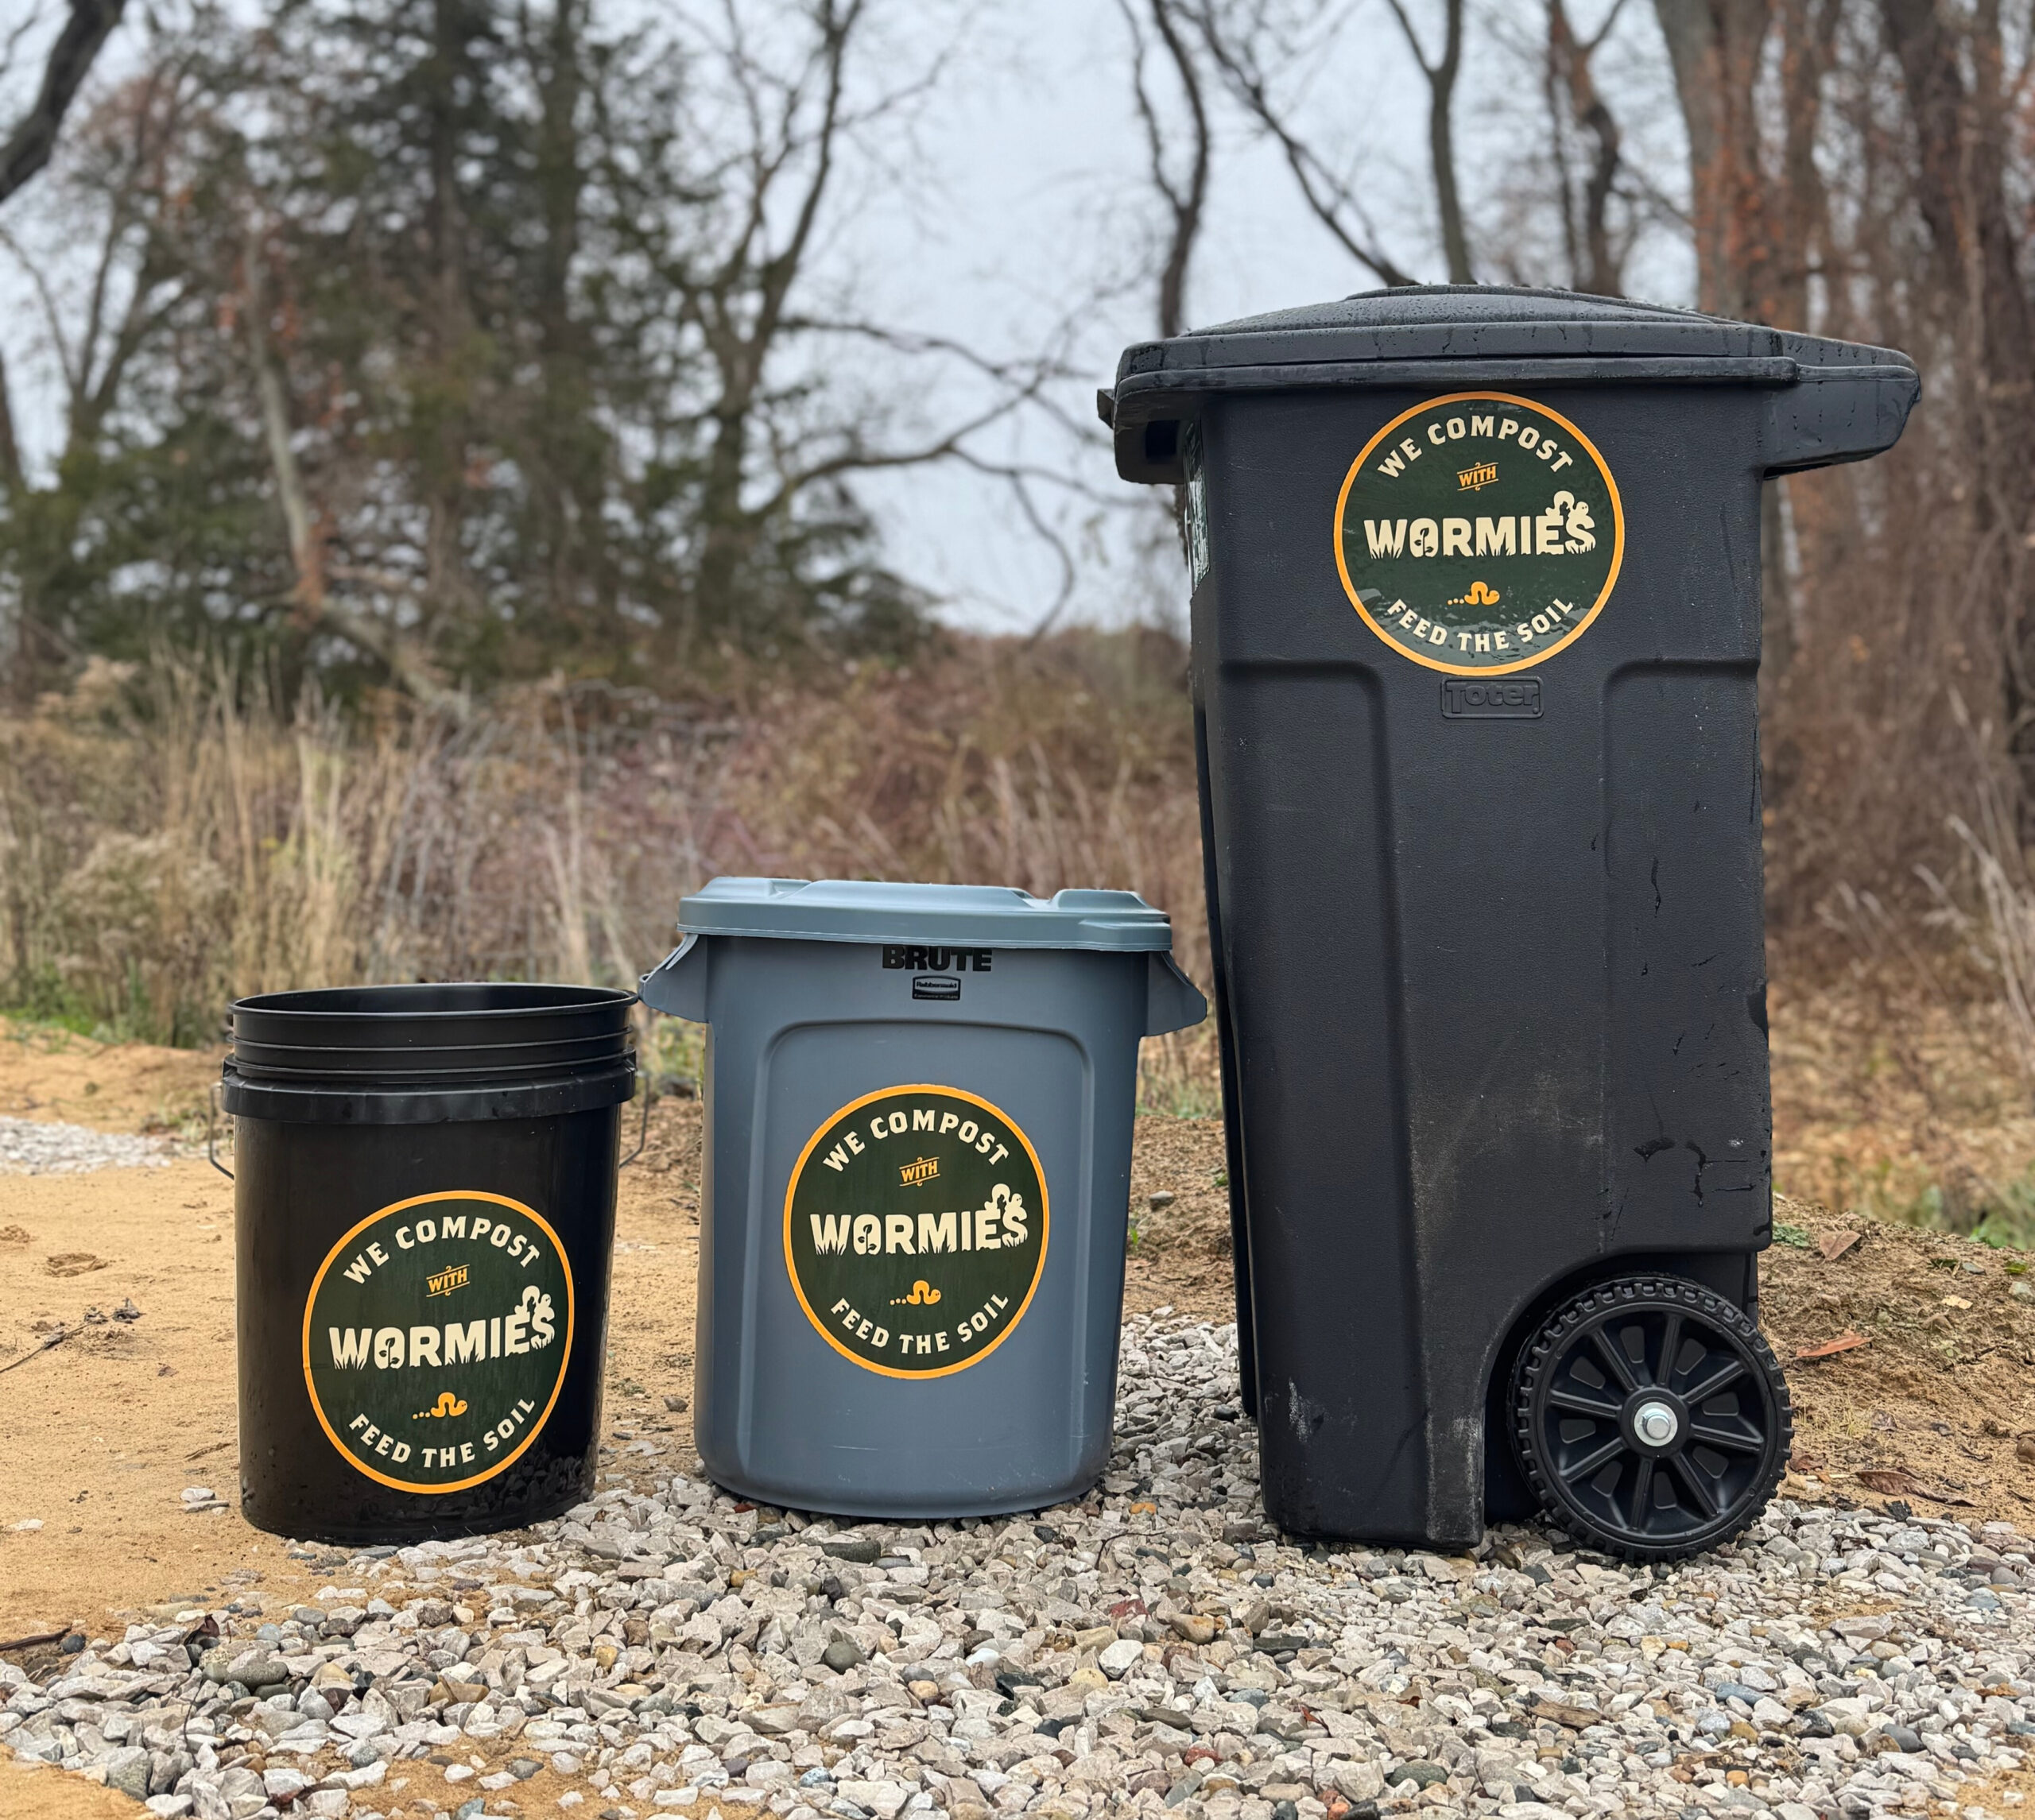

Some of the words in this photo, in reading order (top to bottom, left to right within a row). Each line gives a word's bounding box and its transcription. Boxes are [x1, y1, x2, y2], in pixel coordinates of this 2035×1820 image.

[1378, 437, 1422, 477] WE
[1427, 415, 1573, 473] COMPOST
[1459, 467, 1496, 487] WITH
[1363, 514, 1596, 559] WORMIES
[1387, 598, 1447, 645] FEED
[1458, 630, 1510, 652] THE
[1520, 598, 1573, 642] SOIL
[1446, 681, 1540, 714] Toter
[882, 944, 992, 971] BRUTE
[823, 1131, 866, 1171] WE
[870, 1109, 1009, 1165] COMPOST
[901, 1162, 938, 1183] WITH
[343, 1241, 390, 1284] WE
[395, 1216, 540, 1268] COMPOST
[810, 1206, 1028, 1256] WORMIES
[428, 1268, 467, 1293] WITH
[329, 1306, 555, 1370] WORMIES
[831, 1298, 890, 1347] FEED
[899, 1331, 950, 1354] THE
[957, 1294, 1009, 1342] SOIL
[348, 1413, 411, 1462] FEED
[421, 1442, 475, 1468] THE
[483, 1399, 535, 1451] SOIL
